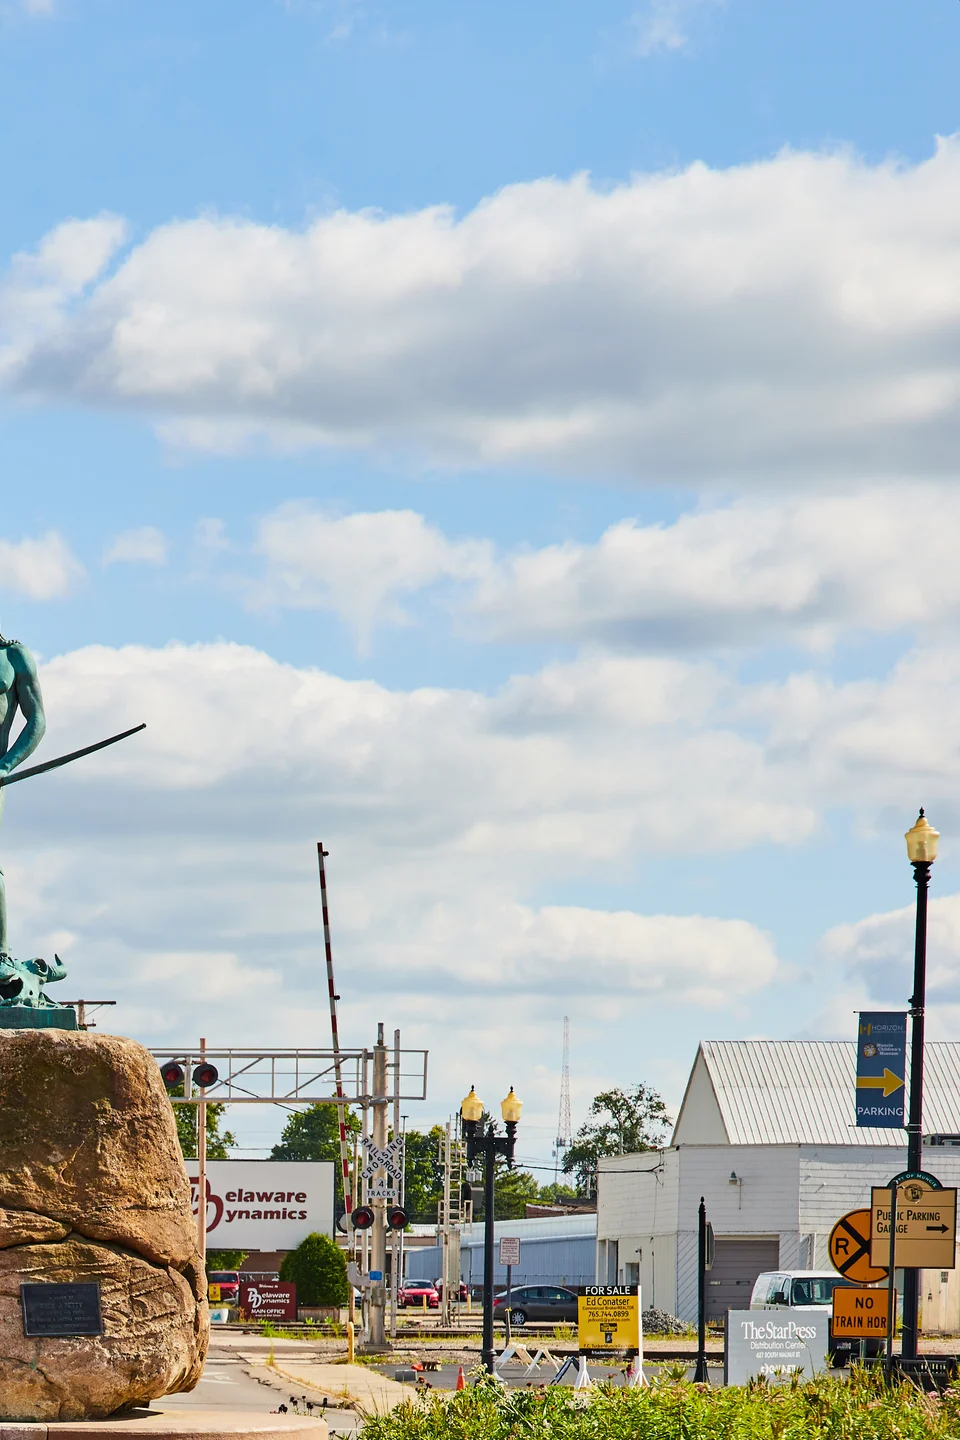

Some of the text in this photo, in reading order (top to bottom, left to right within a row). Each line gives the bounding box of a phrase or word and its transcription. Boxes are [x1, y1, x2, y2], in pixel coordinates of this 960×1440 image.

[857, 1106, 904, 1116] PARKING
[361, 1137, 403, 1179] CROSSING
[361, 1137, 402, 1180] RAILROAD
[378, 1180, 385, 1188] 4
[835, 1237, 849, 1255] R
[585, 1286, 630, 1295] FOR SALE
[586, 1297, 630, 1306] Ed Conatser
[855, 1297, 874, 1309] NO
[588, 1310, 630, 1318] 765.744.0899
[835, 1315, 888, 1328] TRAIN HOR
[750, 1340, 807, 1350] Distribution Center
